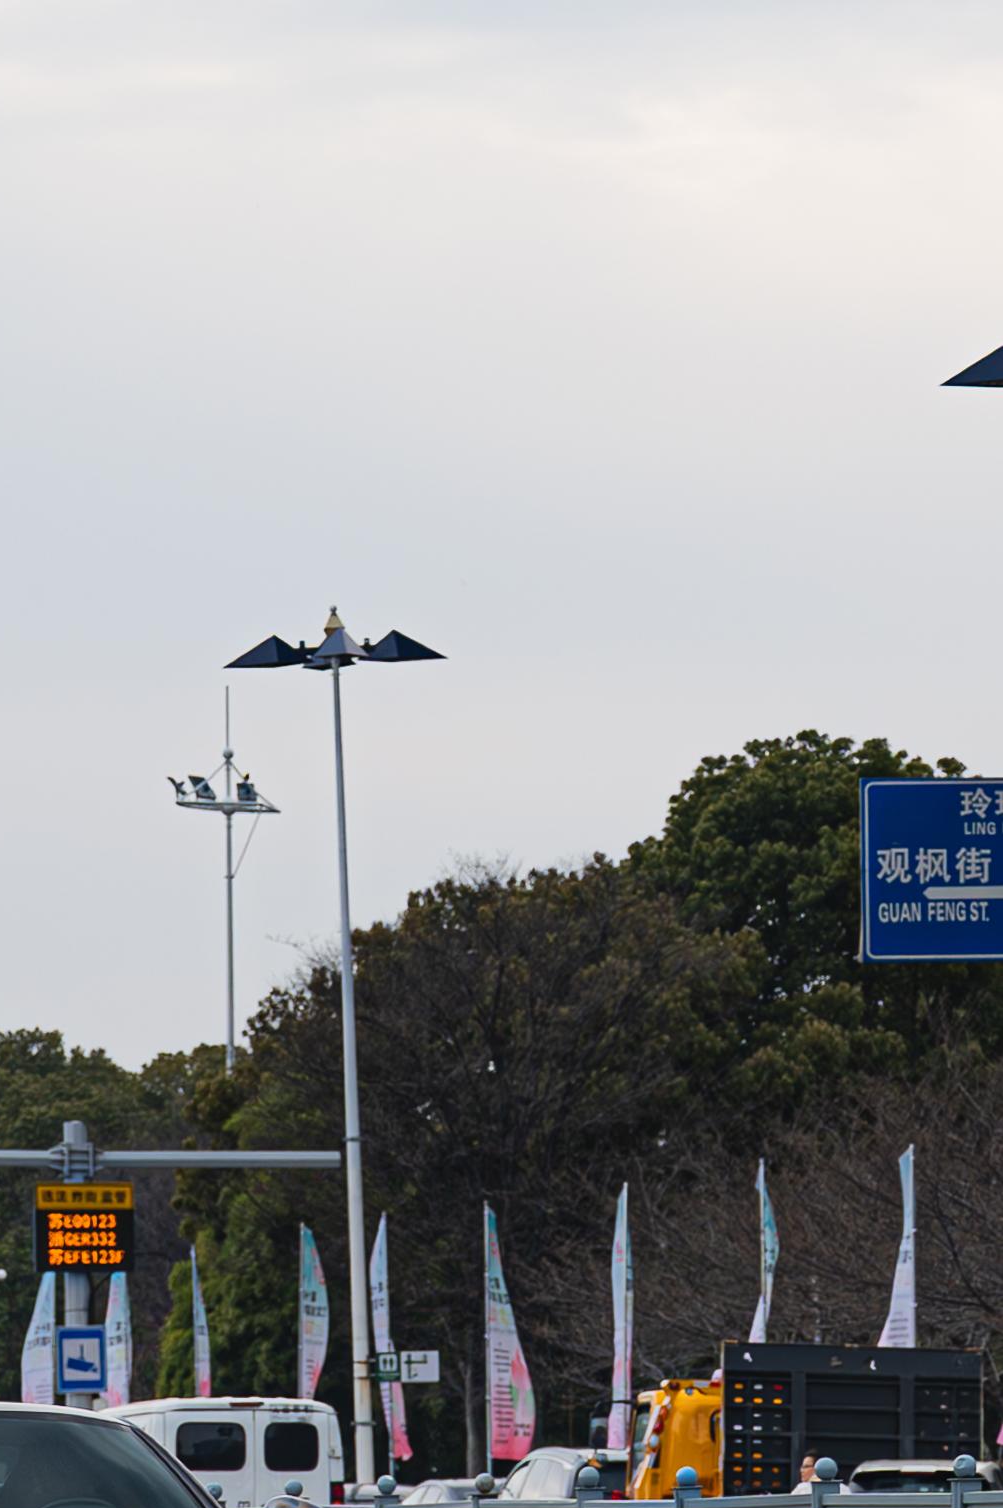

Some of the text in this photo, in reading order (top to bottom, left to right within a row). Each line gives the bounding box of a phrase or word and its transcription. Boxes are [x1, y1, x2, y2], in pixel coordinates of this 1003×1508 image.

[964, 822, 996, 835] LING
[877, 848, 992, 884] 观枫街
[878, 901, 990, 923] GUAN FENG ST.
